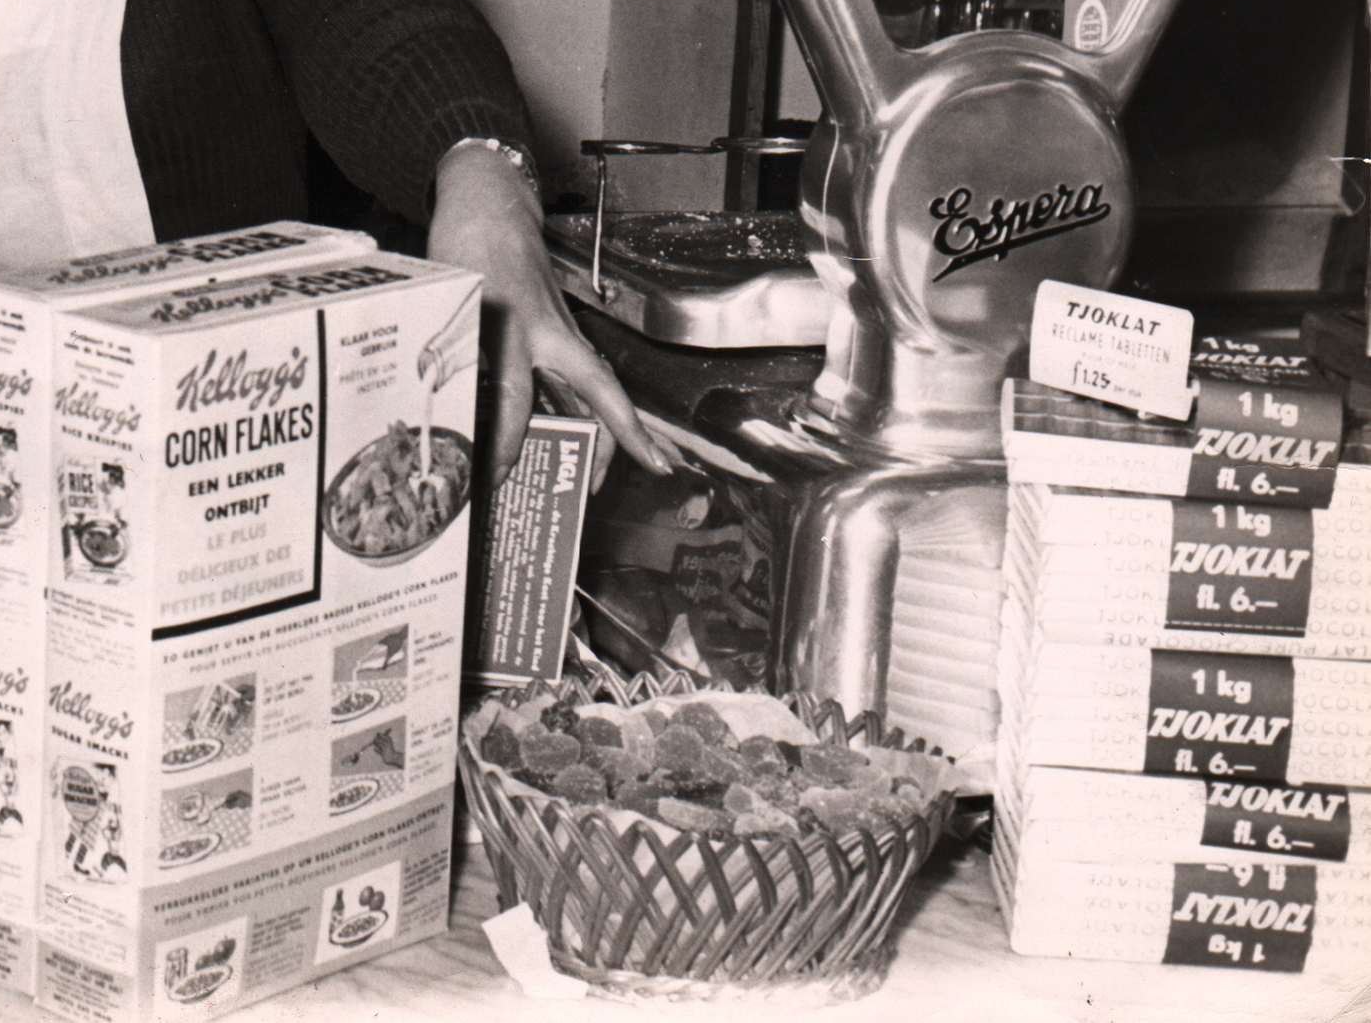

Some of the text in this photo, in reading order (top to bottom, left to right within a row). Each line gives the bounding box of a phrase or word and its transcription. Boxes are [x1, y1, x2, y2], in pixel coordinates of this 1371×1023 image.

[929, 183, 1111, 282] Espera
[1066, 301, 1162, 337] TJOKLAT
[1052, 324, 1172, 364] RECLAME TABLETTEN
[1192, 352, 1308, 368] JOKLAT
[176, 346, 309, 413] Kellogg's
[54, 382, 142, 433] Kellogg's
[1239, 391, 1300, 428] 1 kg
[165, 403, 313, 468] CORN FLAKES
[1191, 428, 1337, 469] TJOKLAT
[188, 462, 285, 497] EEN LEKKER
[552, 439, 580, 495] LIGA
[1216, 467, 1241, 492] fl.
[205, 493, 270, 522] ONTBIJT
[550, 510, 562, 524] de
[1212, 504, 1271, 538] 1 kg
[207, 523, 267, 551] LE PLUS
[543, 524, 560, 575] Krachtige
[266, 544, 292, 565] DES
[1170, 541, 1311, 580] TJOKLAT
[159, 590, 216, 617] PETITS
[540, 577, 553, 601] Kost
[1196, 583, 1221, 610] fl.
[536, 602, 547, 627] voor
[531, 647, 544, 672] Kind
[1192, 669, 1252, 703] 1 kg
[49, 681, 135, 740] Kellogg's
[1146, 707, 1290, 746] TJOKLAT
[86, 739, 130, 761] SMACKS
[1174, 748, 1198, 773] fl.
[1204, 782, 1346, 822] TJOKLAT
[1233, 819, 1256, 847] fl.
[1173, 892, 1313, 932] TJOKLAT
[1208, 935, 1266, 965] 1 kg
